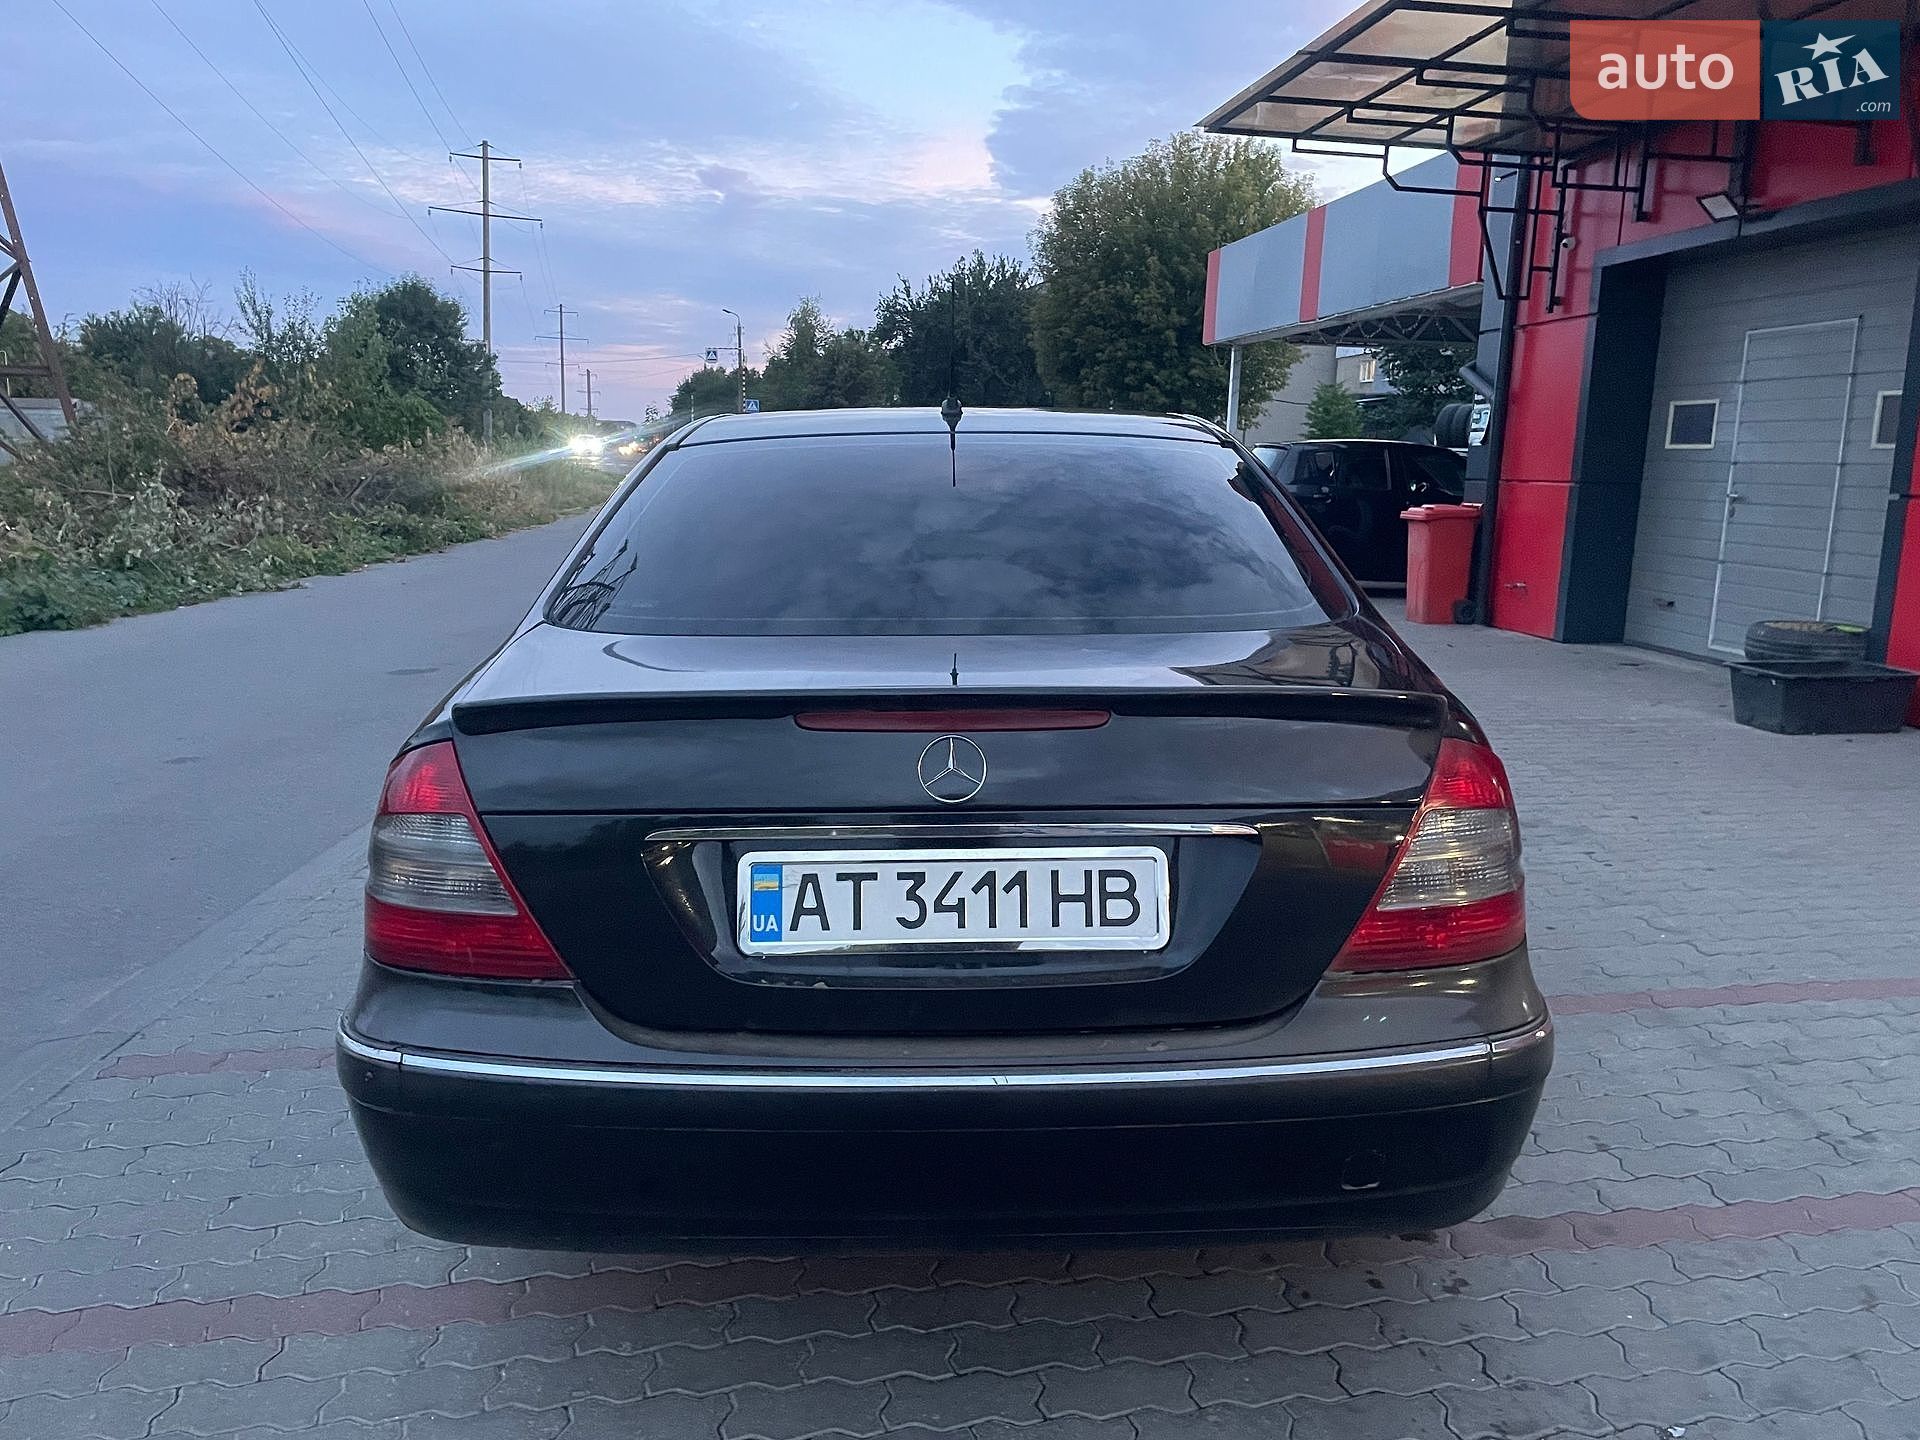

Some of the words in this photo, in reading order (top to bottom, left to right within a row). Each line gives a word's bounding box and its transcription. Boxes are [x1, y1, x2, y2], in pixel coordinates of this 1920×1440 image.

[789, 872, 878, 931] AT
[896, 870, 1029, 930] 3411
[1050, 869, 1141, 928] HB
[753, 914, 779, 932] UA
